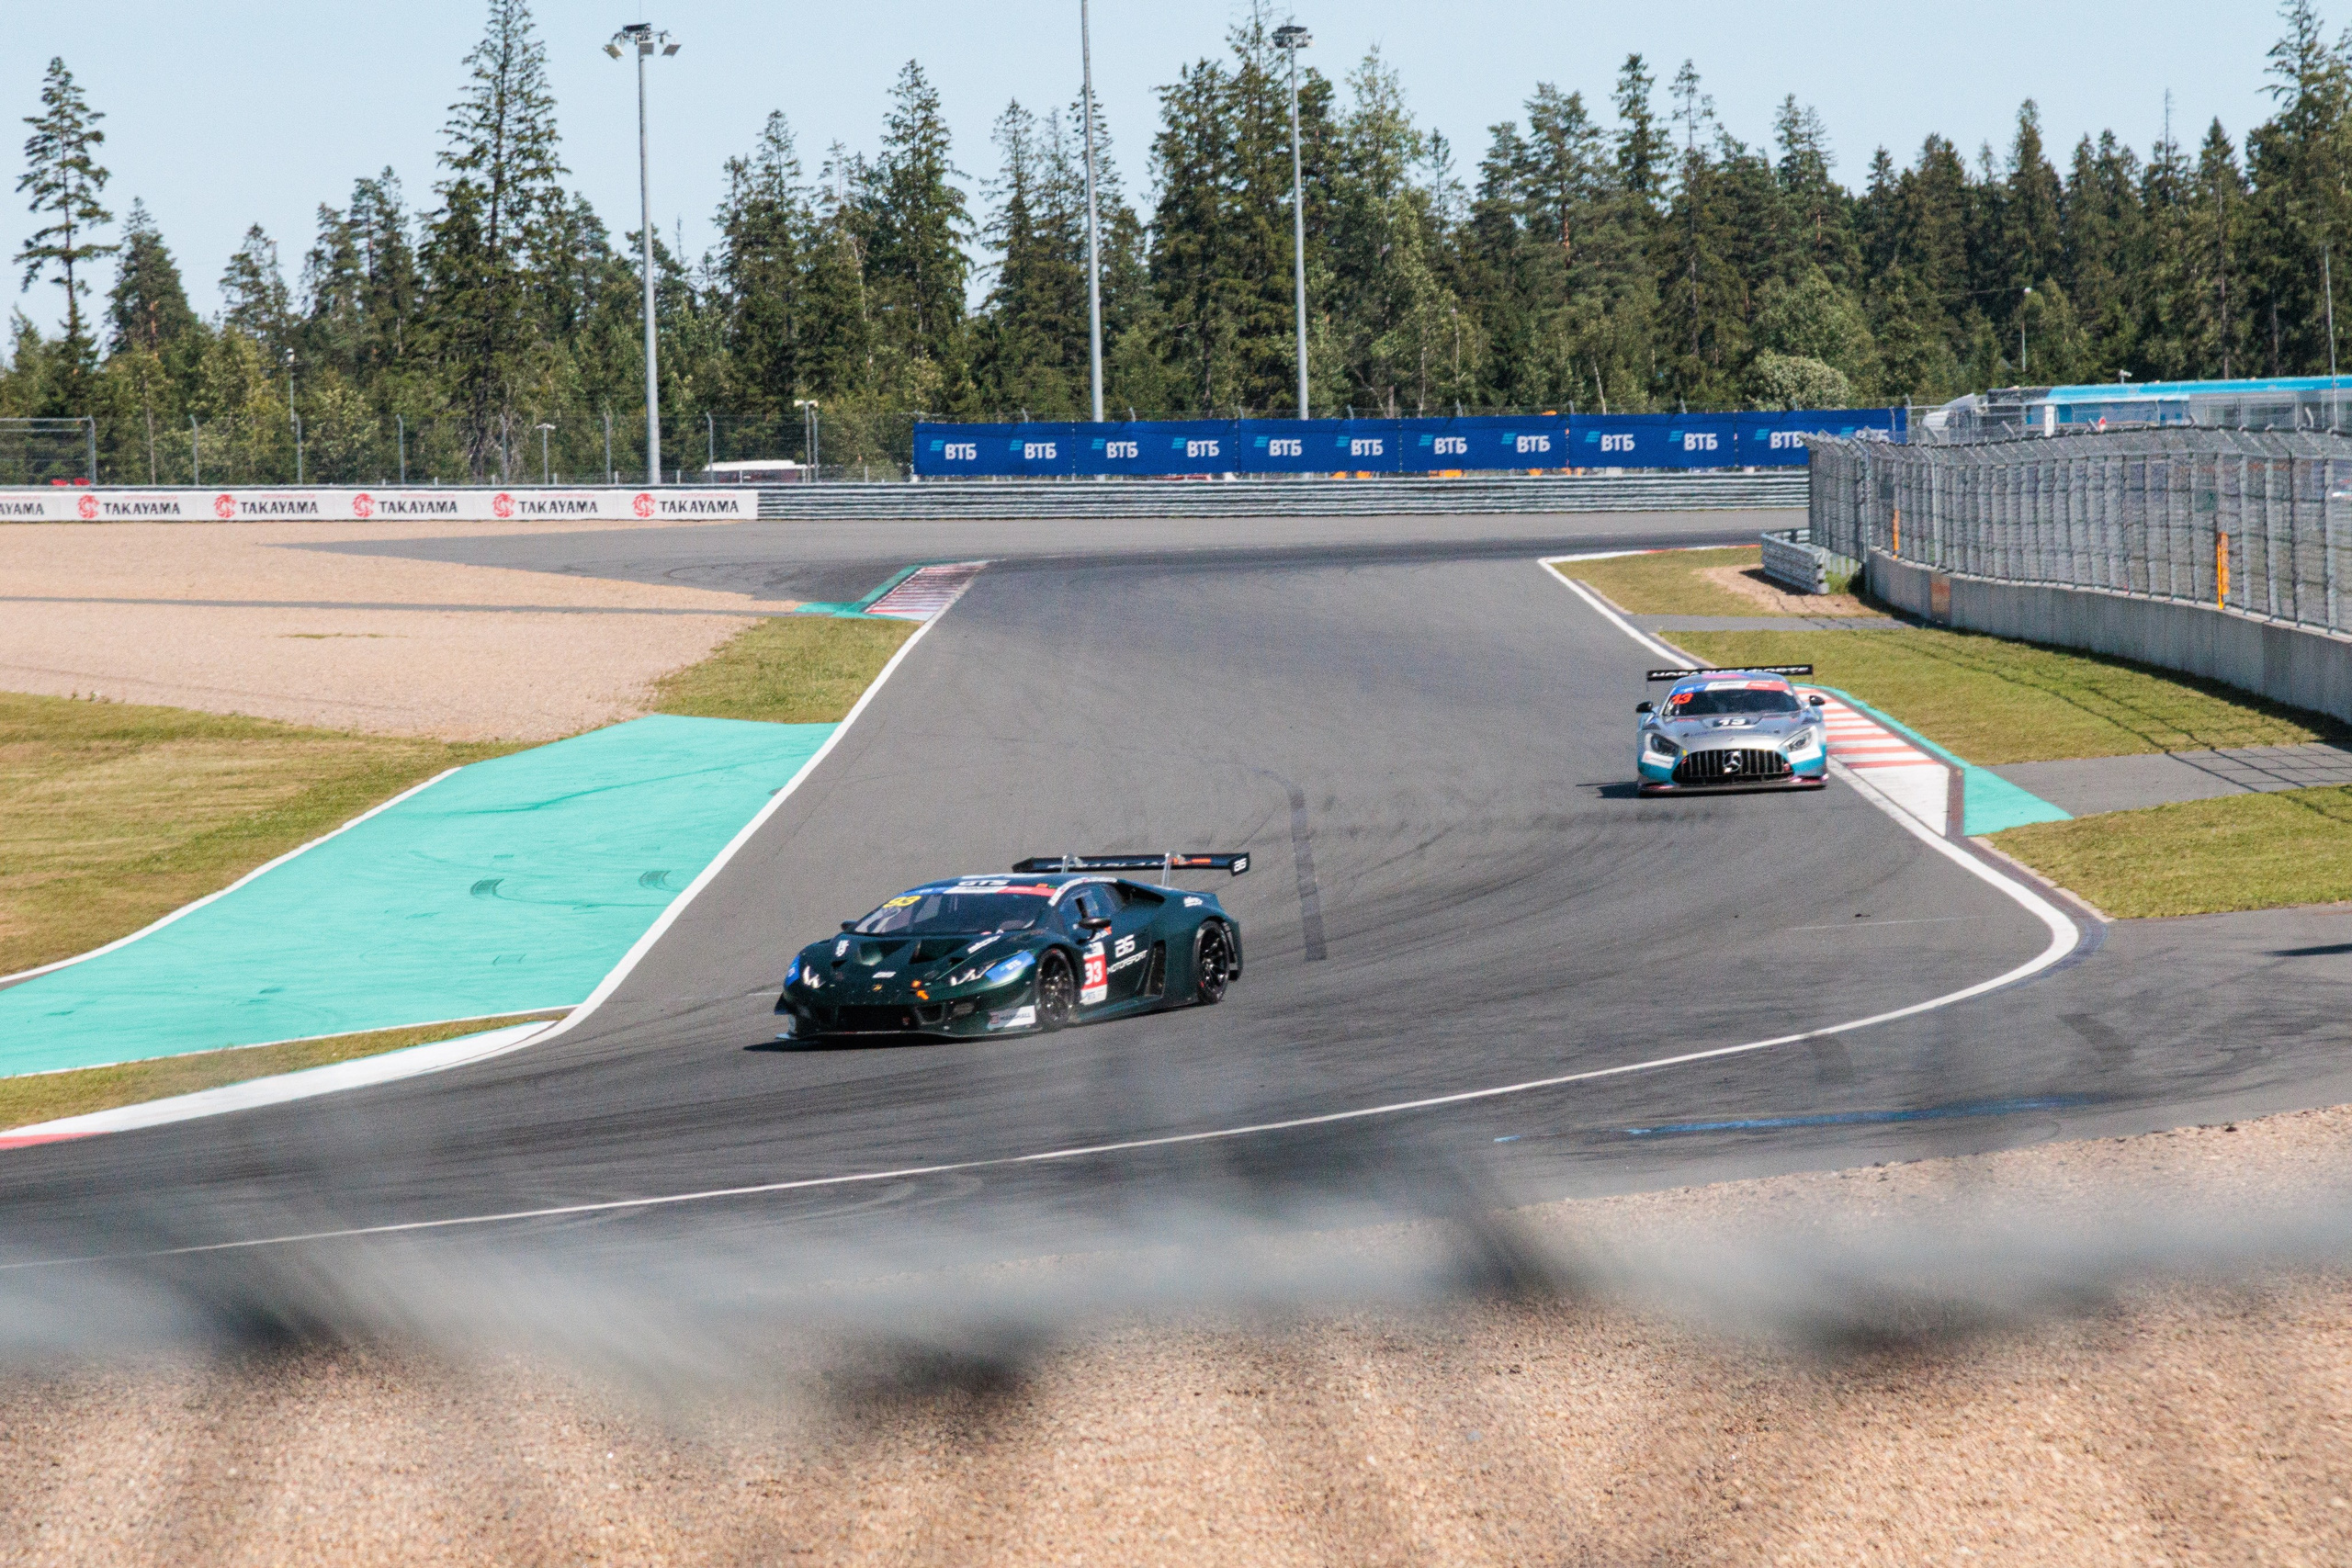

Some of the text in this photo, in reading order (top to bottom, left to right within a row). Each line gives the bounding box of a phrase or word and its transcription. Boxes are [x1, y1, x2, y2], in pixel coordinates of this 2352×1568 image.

[1187, 440, 1220, 457] ВТБ
[1269, 439, 1302, 457] ВТБ
[1351, 439, 1384, 457] ВТБ
[1434, 436, 1467, 455] ВТБ
[1517, 435, 1551, 453] ВТБ
[1601, 434, 1635, 452] ВТБ
[1684, 433, 1718, 451] ВТБ
[1770, 431, 1804, 449] ВТБ
[944, 443, 977, 460] ВТБ
[1024, 443, 1057, 459] ВТБ
[1106, 441, 1138, 458] ВТБ
[103, 502, 181, 515] TAKAYAMA
[241, 501, 319, 514] TAKAYAMA
[379, 501, 458, 514] TAKAYAMA
[518, 500, 598, 514] TAKAYAMA
[659, 500, 739, 513] TAKAYAMA
[1671, 692, 1693, 705] 13
[1718, 717, 1746, 726] 13
[1107, 950, 1148, 975] MOTORSPORT
